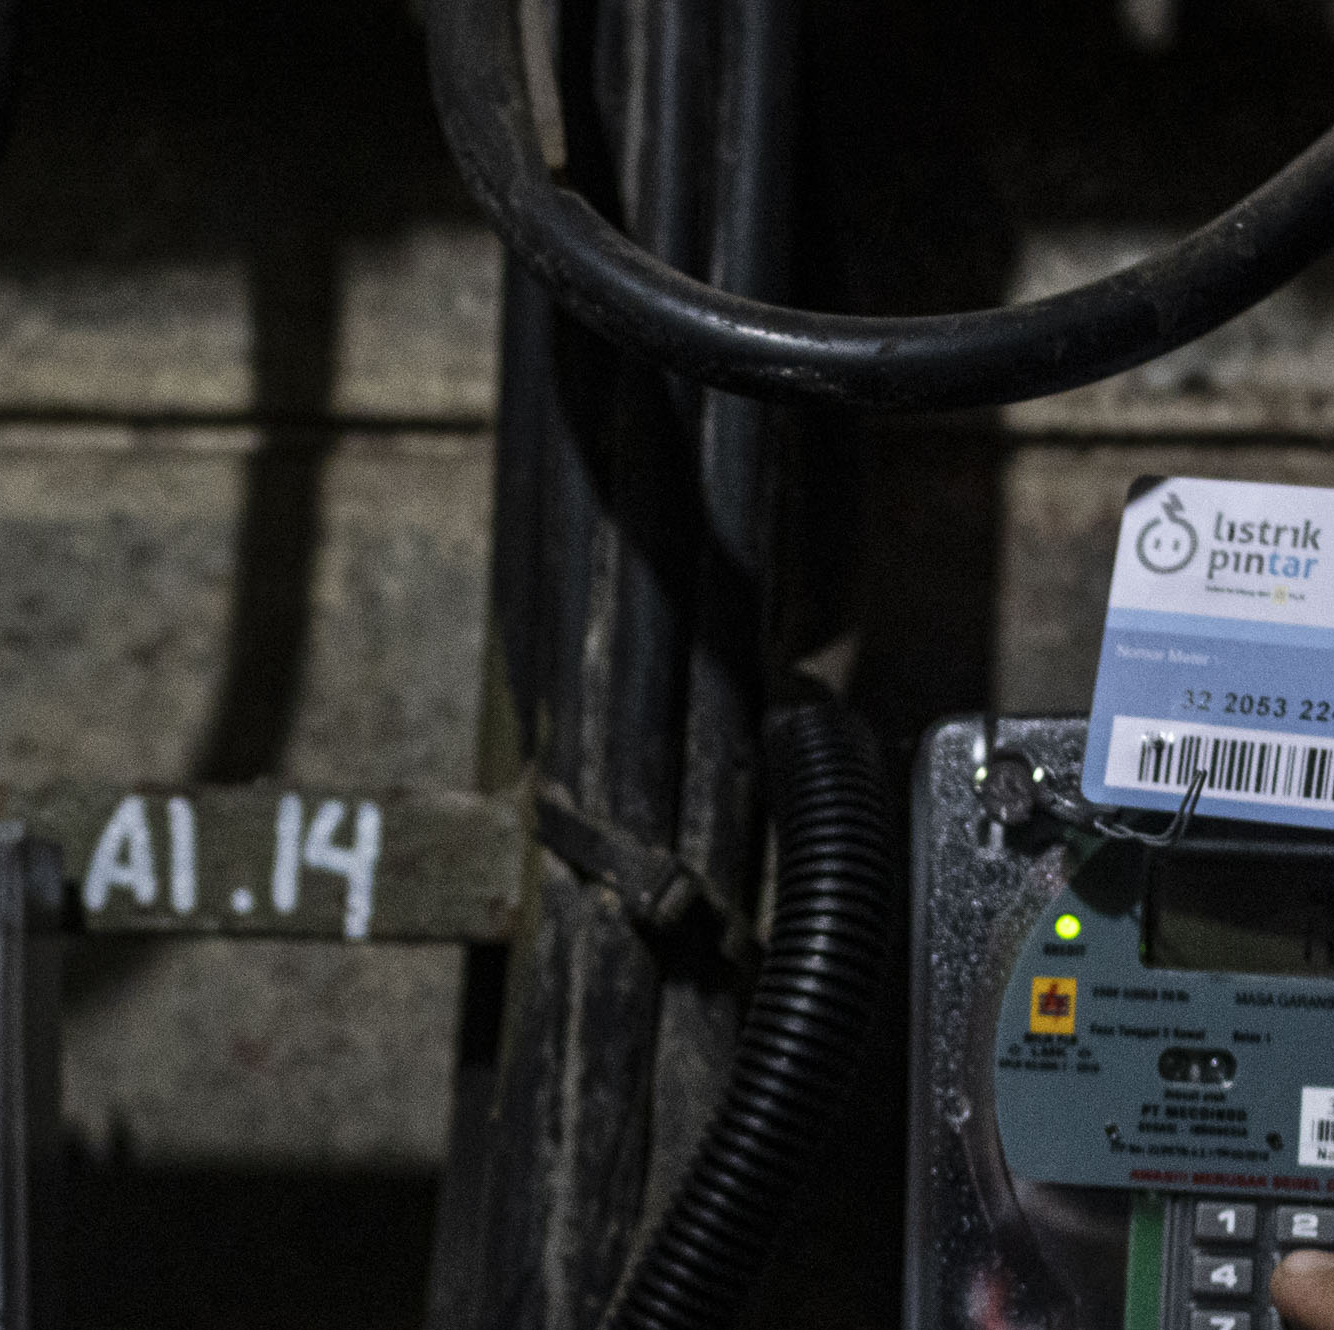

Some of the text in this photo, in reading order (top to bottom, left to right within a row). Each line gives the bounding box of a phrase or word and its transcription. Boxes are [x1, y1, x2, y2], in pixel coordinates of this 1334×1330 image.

[1213, 511, 1323, 550] listrik
[1206, 550, 1319, 580] pintar
[1182, 688, 1212, 711] 32
[1224, 692, 1287, 719] 2053
[1218, 1209, 1237, 1235] 1
[1291, 1213, 1319, 1239] 2
[1210, 1263, 1238, 1289] 4
